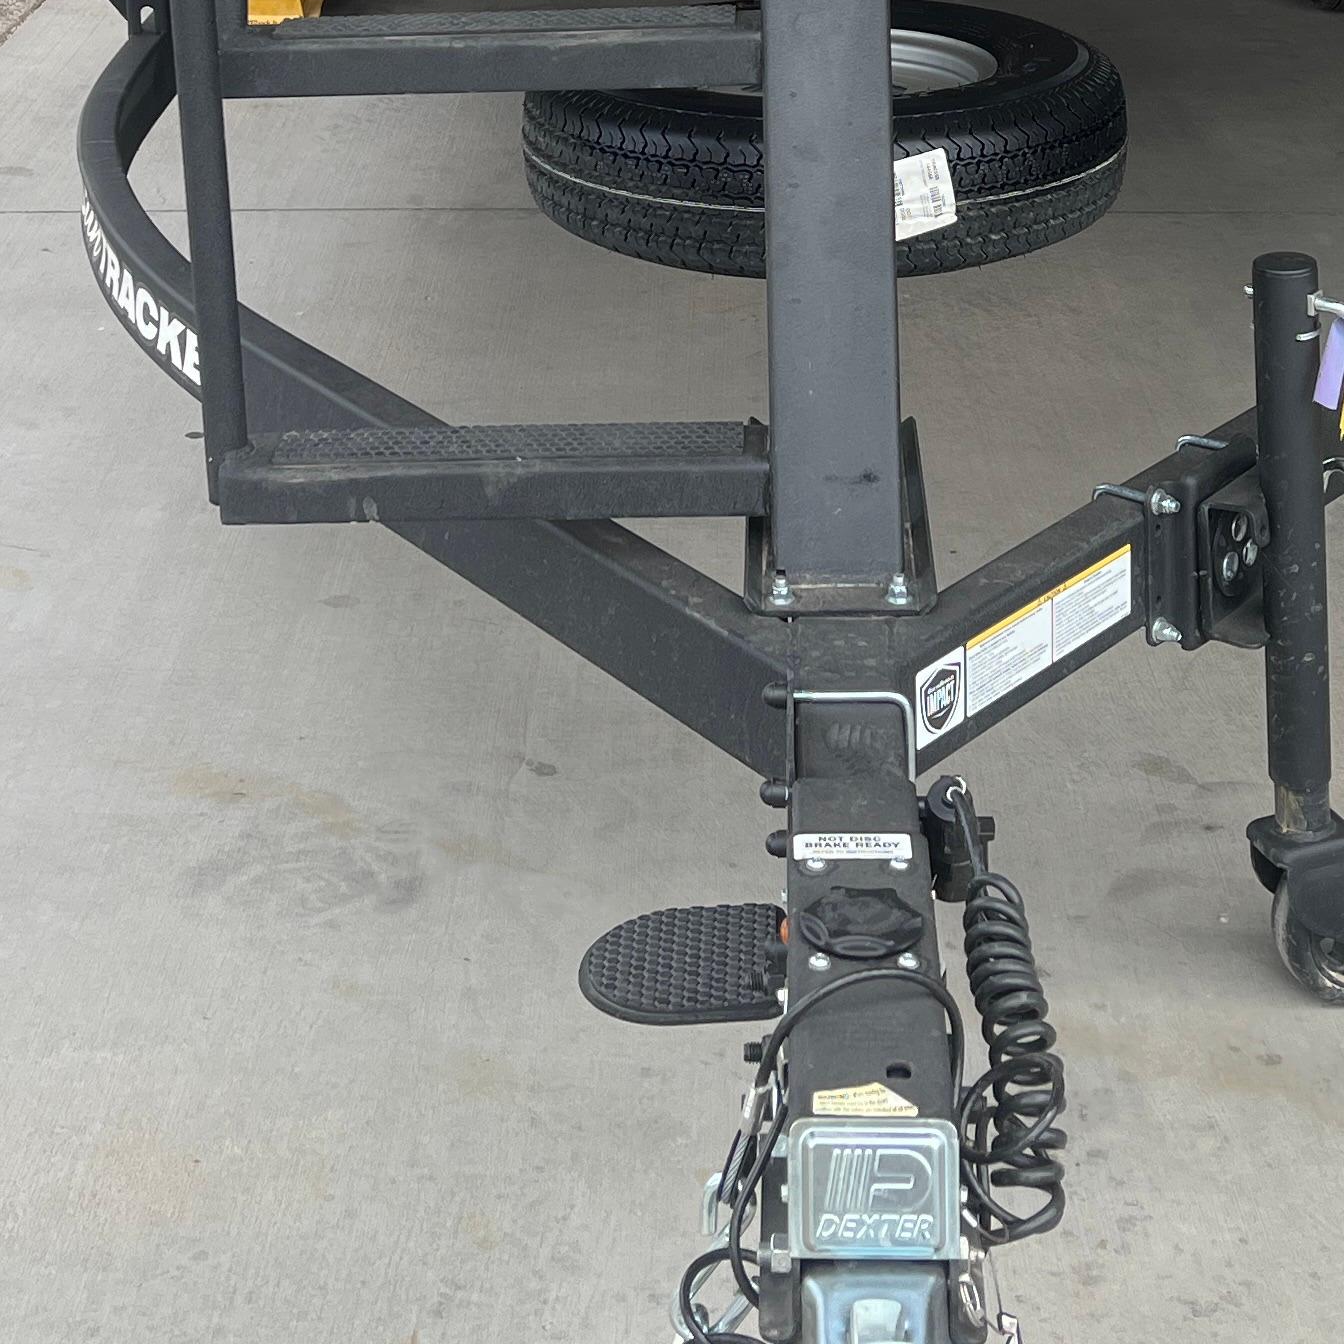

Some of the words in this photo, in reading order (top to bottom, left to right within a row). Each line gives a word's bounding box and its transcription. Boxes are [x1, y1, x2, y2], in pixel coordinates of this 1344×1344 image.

[98, 232, 202, 387] TRACKE
[926, 679, 955, 717] IMPACT
[818, 835, 842, 843] NOT
[849, 835, 882, 843] DISC
[815, 1213, 934, 1240] DEXTER
